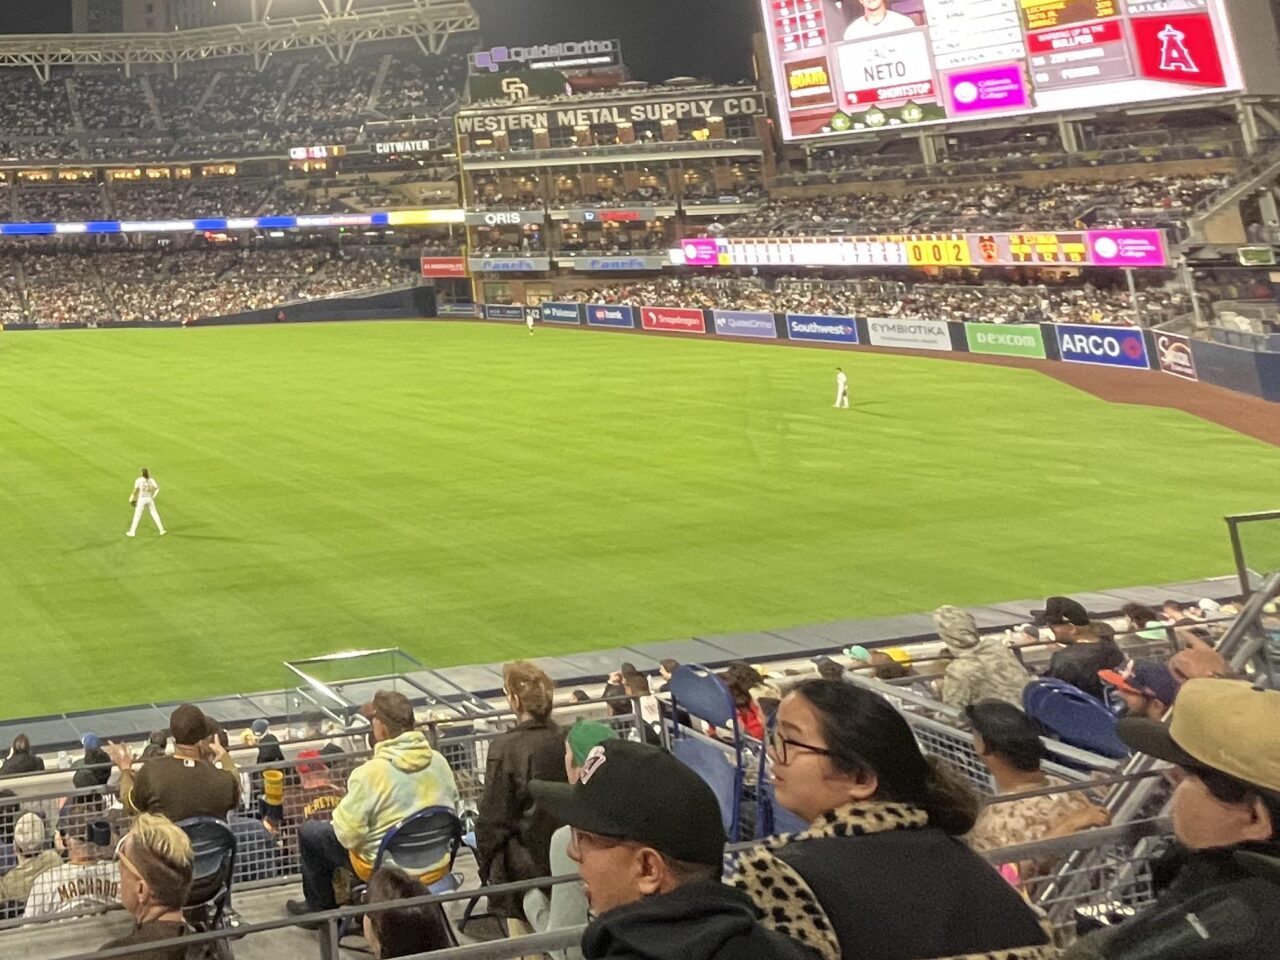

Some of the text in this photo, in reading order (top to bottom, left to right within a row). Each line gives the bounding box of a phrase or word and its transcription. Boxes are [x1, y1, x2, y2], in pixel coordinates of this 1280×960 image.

[863, 61, 906, 82] NETO
[877, 83, 930, 100] SHORTSTOP
[457, 97, 763, 133] WESTERN METAL SUPPLY CO.
[375, 140, 429, 154] CUTWATER
[485, 212, 520, 225] ORIS
[912, 243, 963, 261] 0 0 2
[658, 313, 700, 327] Snapdragon
[791, 320, 845, 335] Southwest
[1061, 333, 1120, 357] ARCO
[57, 878, 118, 903] MACHADO
